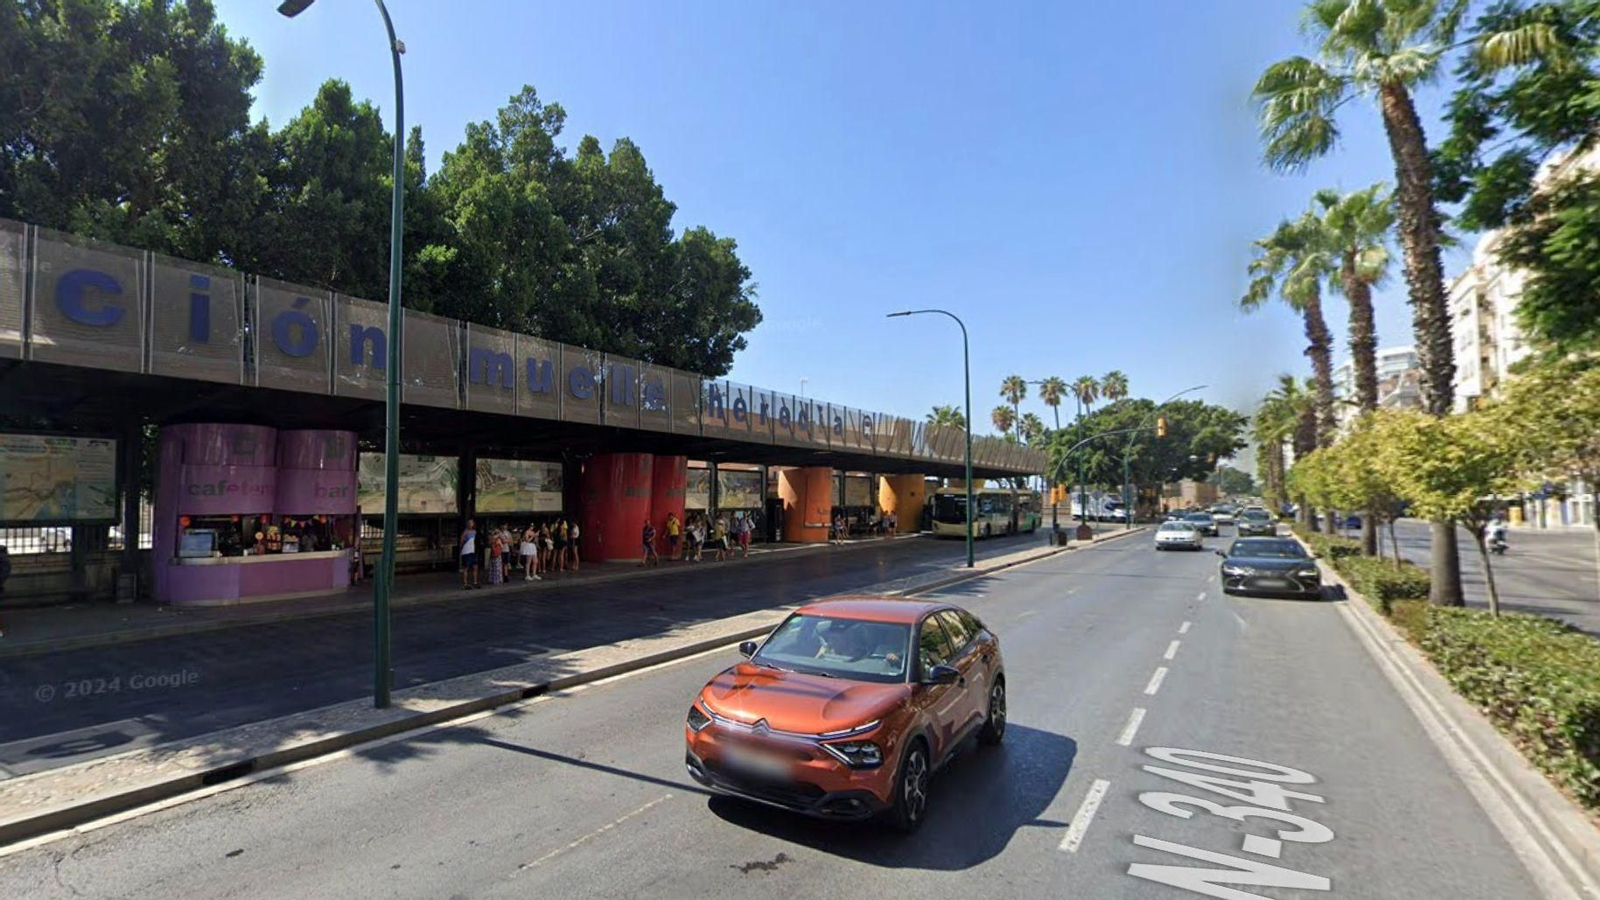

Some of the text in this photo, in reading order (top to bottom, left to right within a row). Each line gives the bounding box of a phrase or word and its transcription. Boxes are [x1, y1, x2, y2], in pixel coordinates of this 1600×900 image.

[470, 348, 666, 410] muelle
[708, 383, 842, 436] heredia
[314, 482, 350, 498] bar
[1127, 746, 1335, 900] N-340
